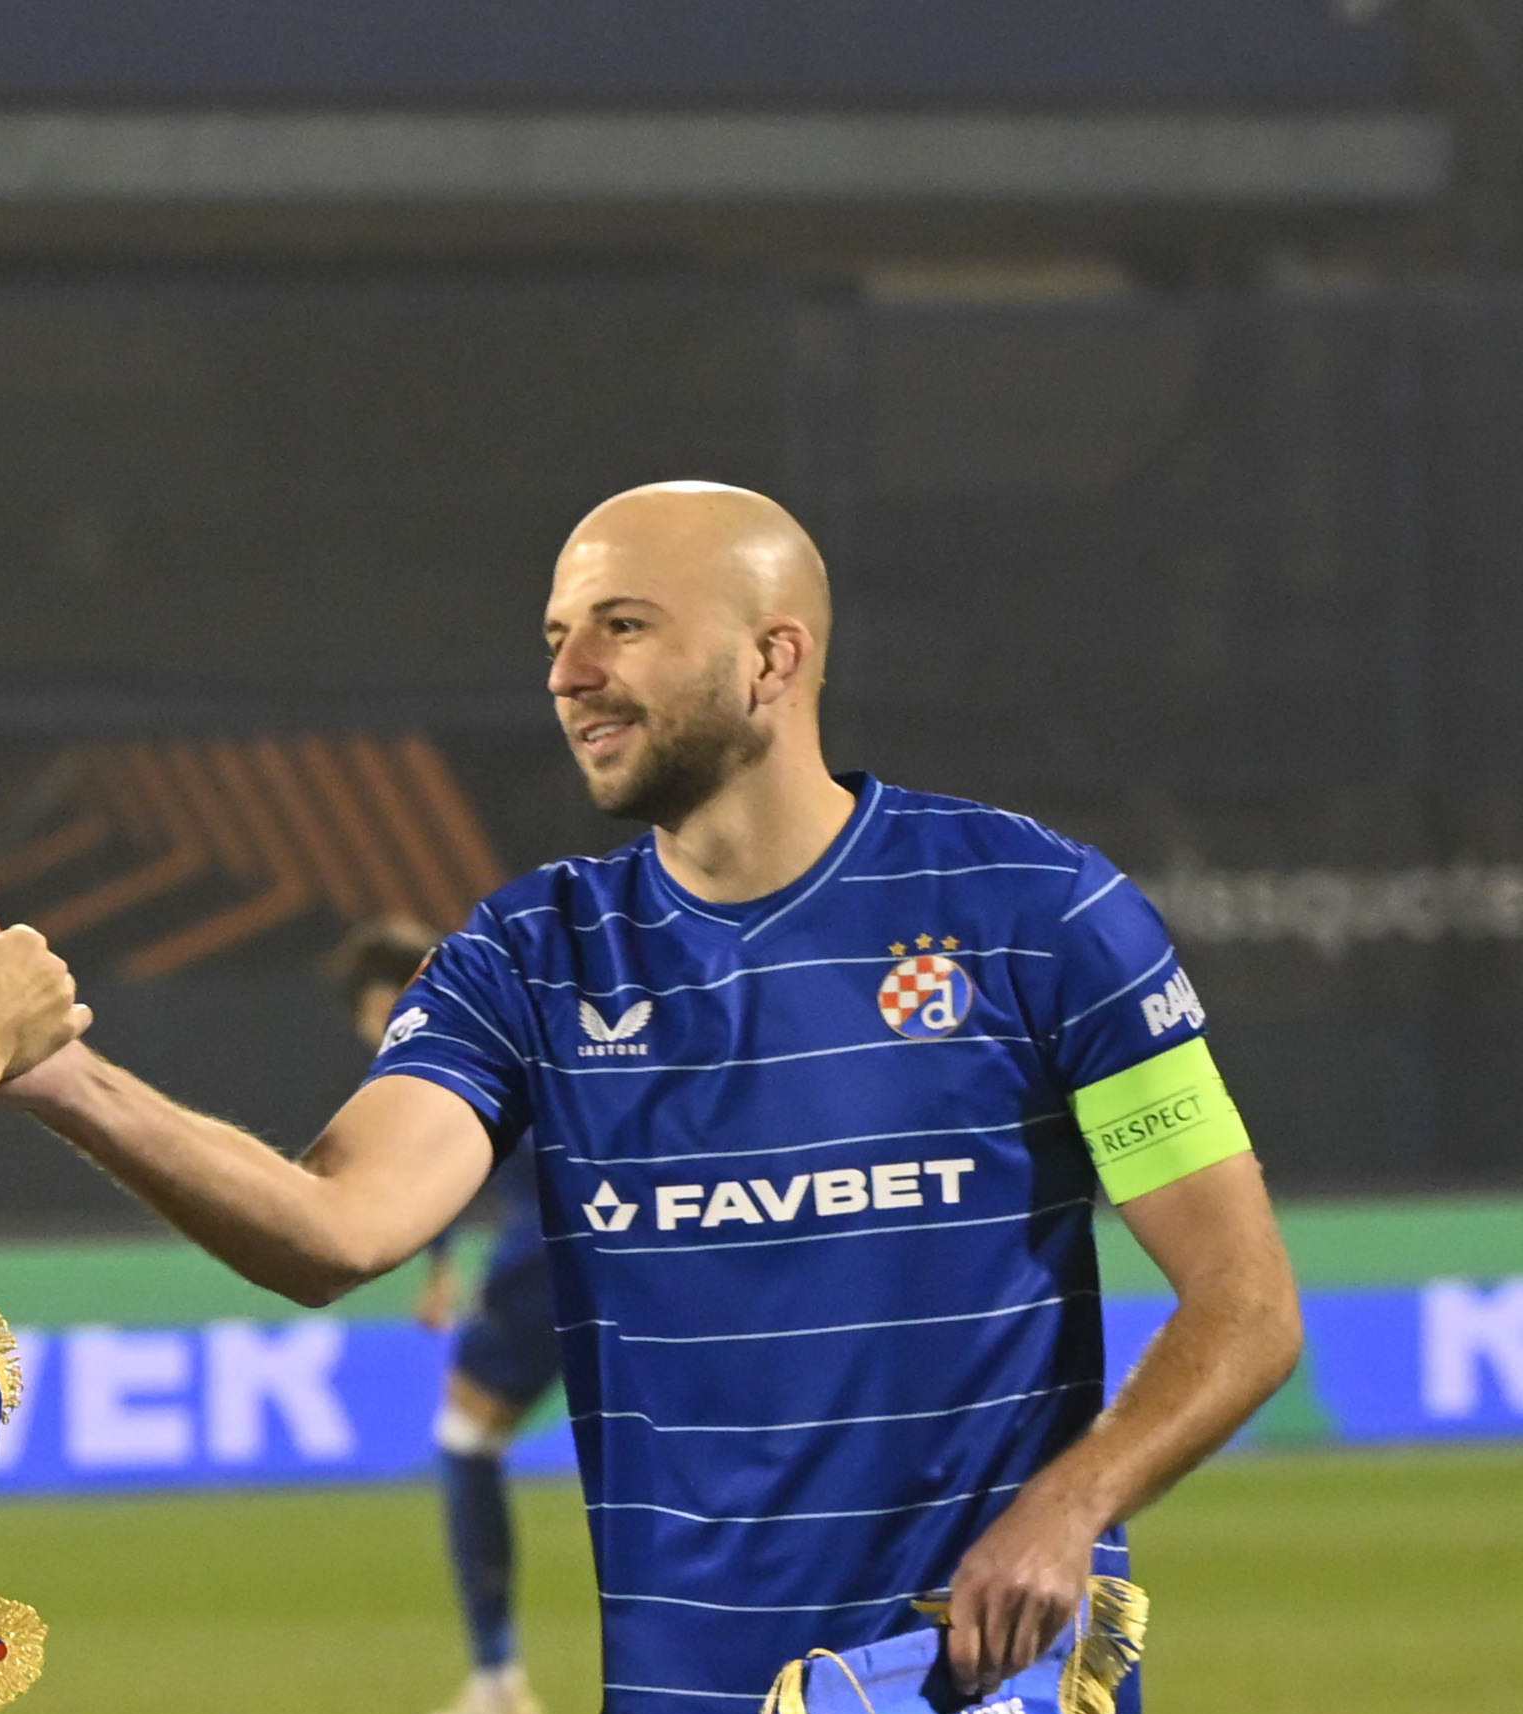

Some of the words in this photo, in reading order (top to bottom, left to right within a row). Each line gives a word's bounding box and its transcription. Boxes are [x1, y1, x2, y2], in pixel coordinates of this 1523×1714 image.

[577, 1043, 649, 1057] CASTORE
[1101, 1095, 1202, 1154] RESPECT
[655, 1158, 975, 1231] FAVBET
